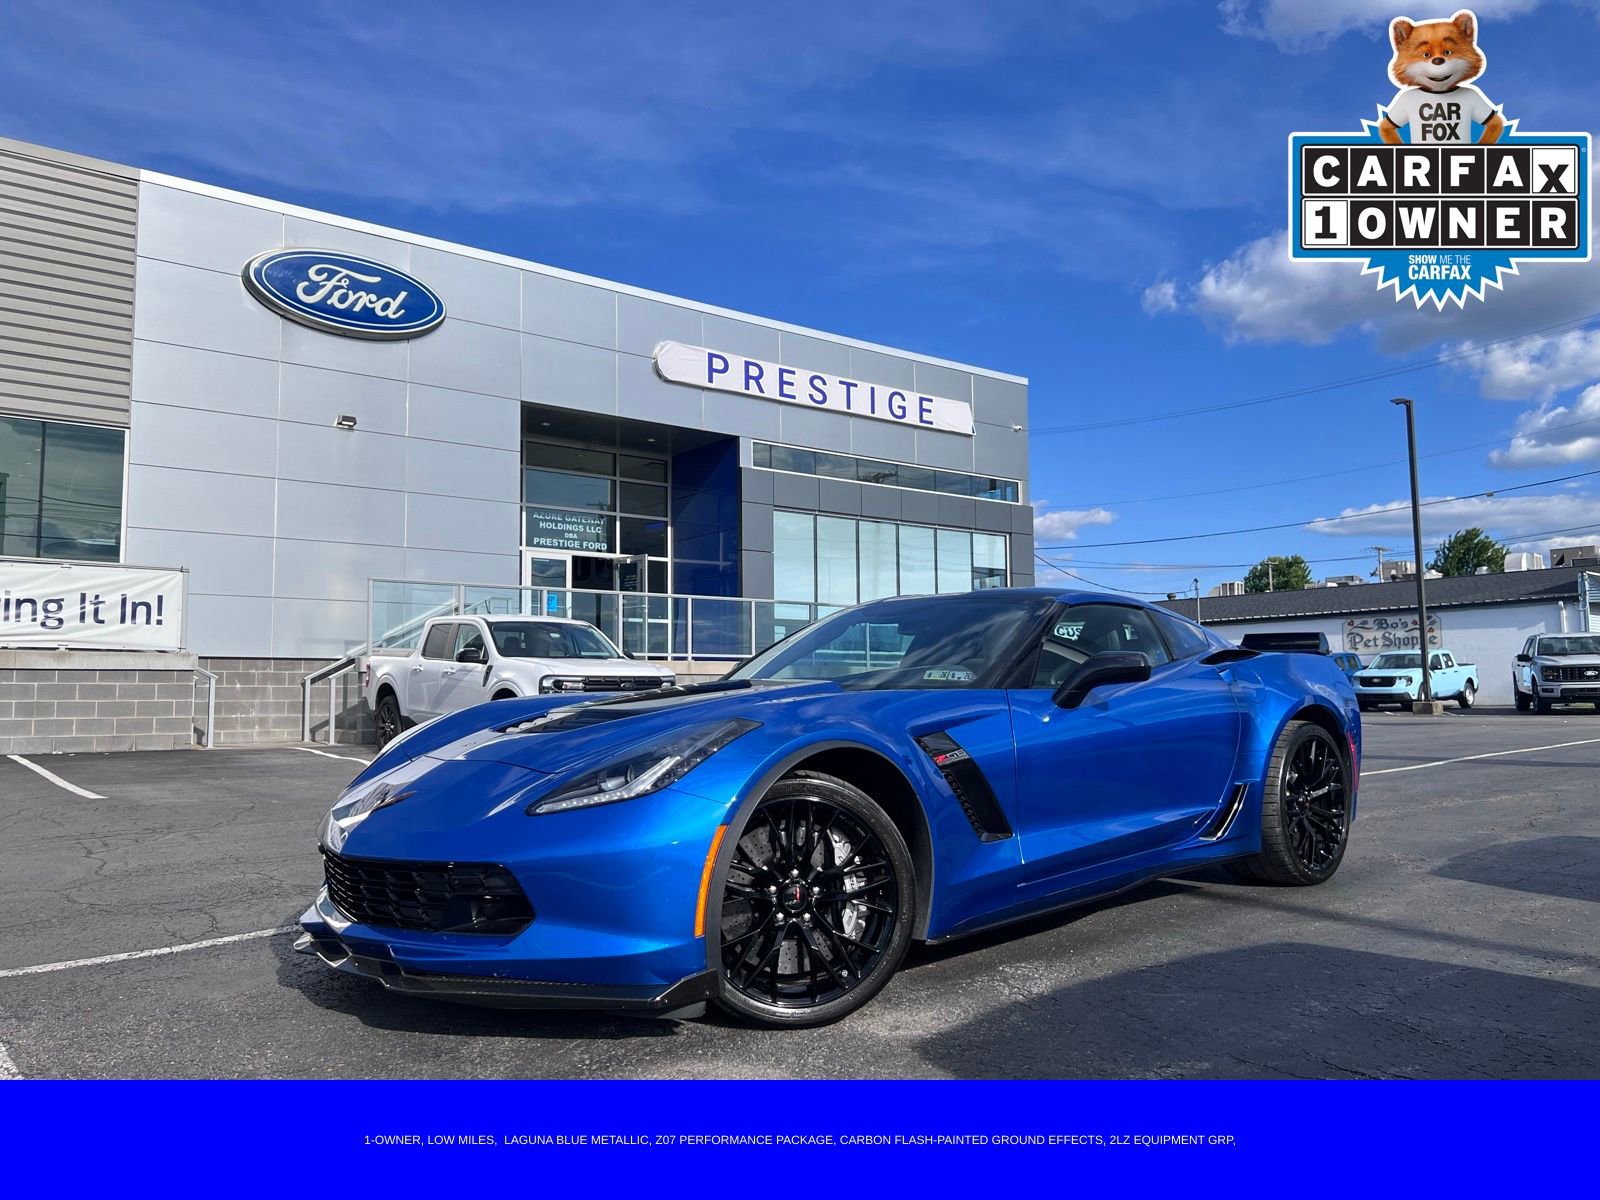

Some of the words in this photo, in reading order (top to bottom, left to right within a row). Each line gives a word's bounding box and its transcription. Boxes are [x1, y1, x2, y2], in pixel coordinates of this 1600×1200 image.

[296, 264, 408, 319] Ford
[706, 352, 934, 425] PRESTIGE
[533, 511, 563, 521] AZURE
[565, 514, 606, 525] GATEWAY
[539, 521, 584, 532] HOLDINGS
[586, 525, 602, 533] LLC
[533, 537, 580, 548] PRESTIGE
[583, 541, 607, 550] FORD
[0, 590, 65, 630] ing
[79, 592, 106, 624] It
[119, 593, 164, 626] In!
[1373, 618, 1409, 630] Bo's
[1346, 632, 1380, 651] Pet
[1382, 631, 1438, 650] Shope
